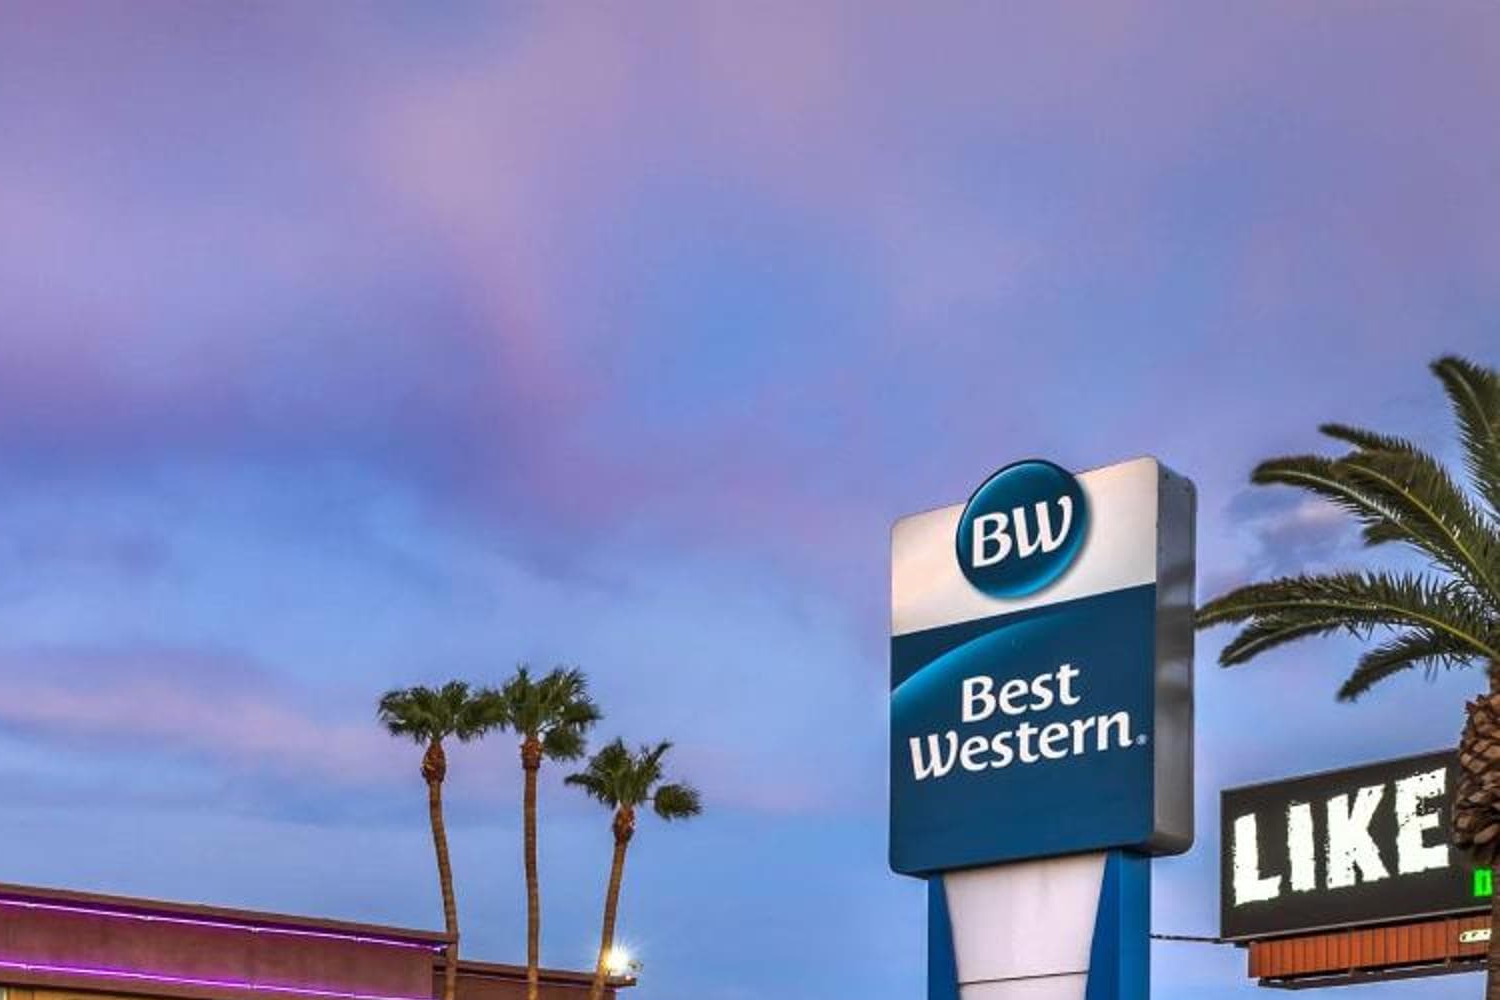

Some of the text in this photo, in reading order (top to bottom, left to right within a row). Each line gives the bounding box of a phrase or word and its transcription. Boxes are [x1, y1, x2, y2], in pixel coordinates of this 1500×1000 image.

[972, 496, 1073, 568] BW
[962, 663, 1080, 723] Best
[1233, 767, 1449, 907] LIKE
